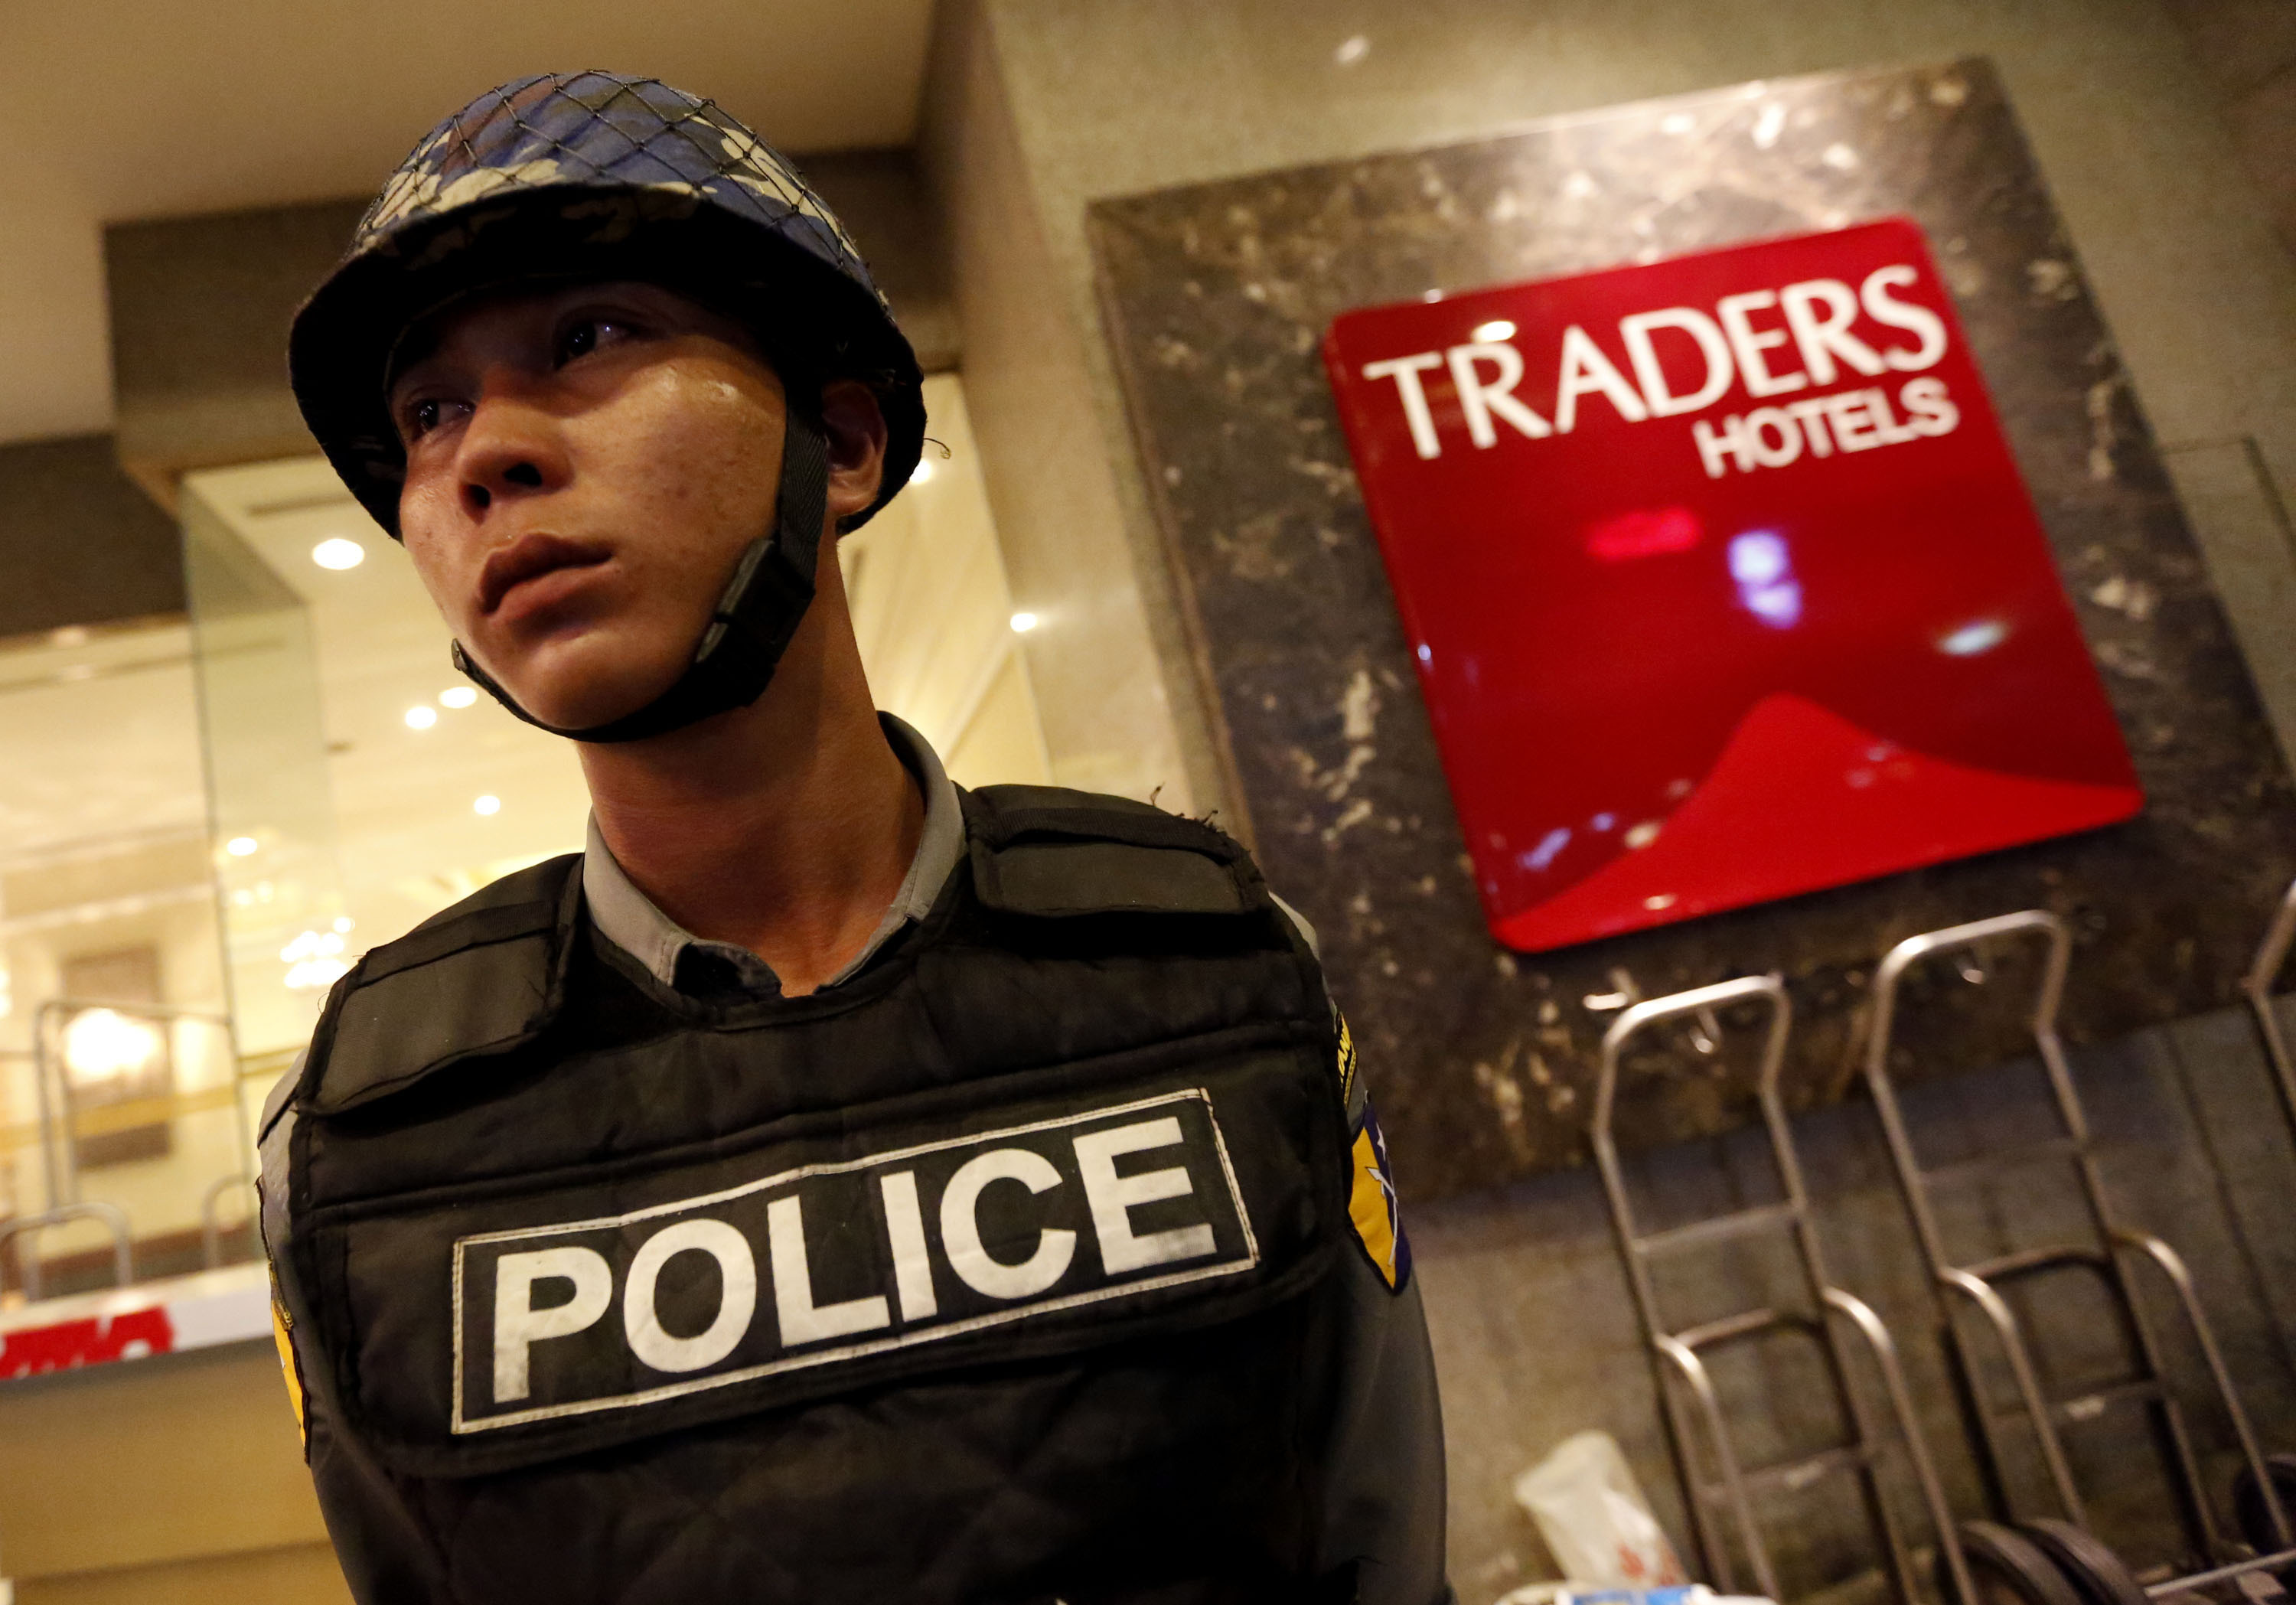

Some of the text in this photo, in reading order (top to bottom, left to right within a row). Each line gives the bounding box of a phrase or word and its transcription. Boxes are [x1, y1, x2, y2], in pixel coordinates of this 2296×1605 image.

[1362, 265, 1949, 460] TRADERS
[1694, 377, 1960, 478] HOTELS
[494, 1117, 1217, 1403] POLICE
